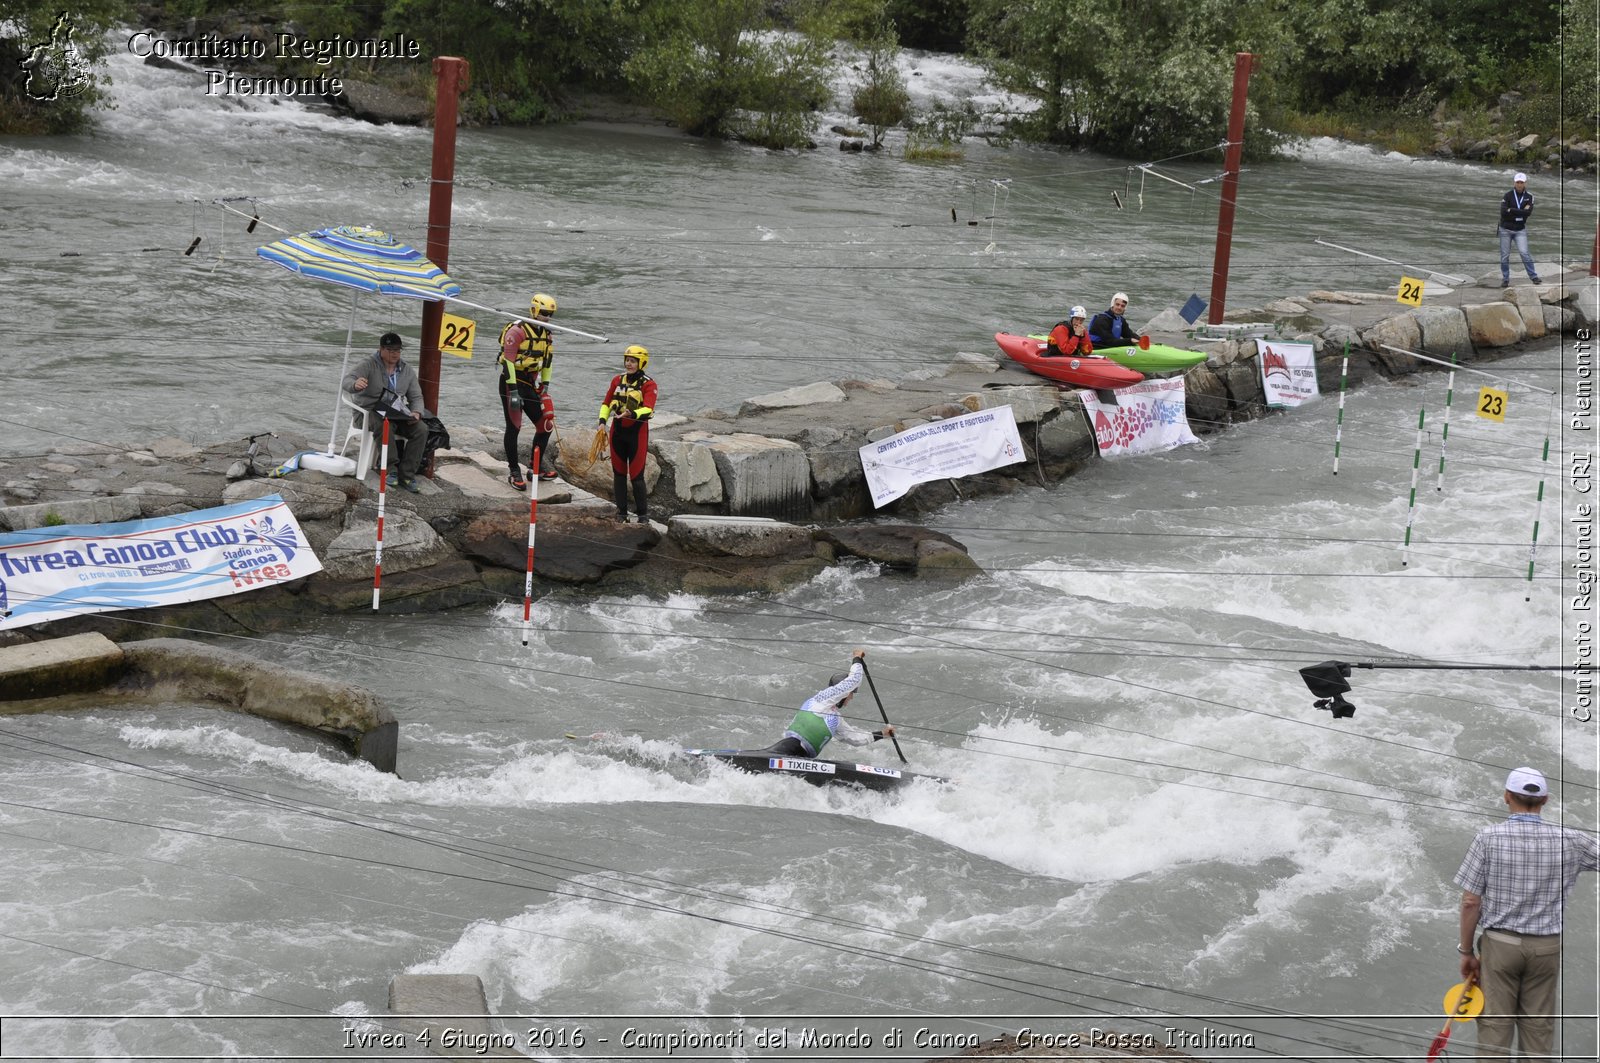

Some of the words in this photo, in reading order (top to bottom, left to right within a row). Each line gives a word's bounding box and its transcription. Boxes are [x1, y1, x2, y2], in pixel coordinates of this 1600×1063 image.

[1401, 283, 1420, 302] 24
[443, 322, 471, 352] 22
[1481, 393, 1503, 416] 23
[877, 440, 898, 454] CENTRO
[897, 437, 905, 446] DI
[941, 421, 959, 433] SPORT
[960, 420, 965, 428] E
[965, 413, 995, 427] FISIOTERAPIA
[0, 549, 86, 577] Ivrea
[86, 540, 177, 566] Canoa
[175, 524, 241, 553] Club
[223, 547, 252, 559] Stadio
[254, 545, 273, 554] della
[229, 563, 292, 588] Ivrea
[787, 761, 818, 771] TIXIER
[820, 764, 830, 772] C.
